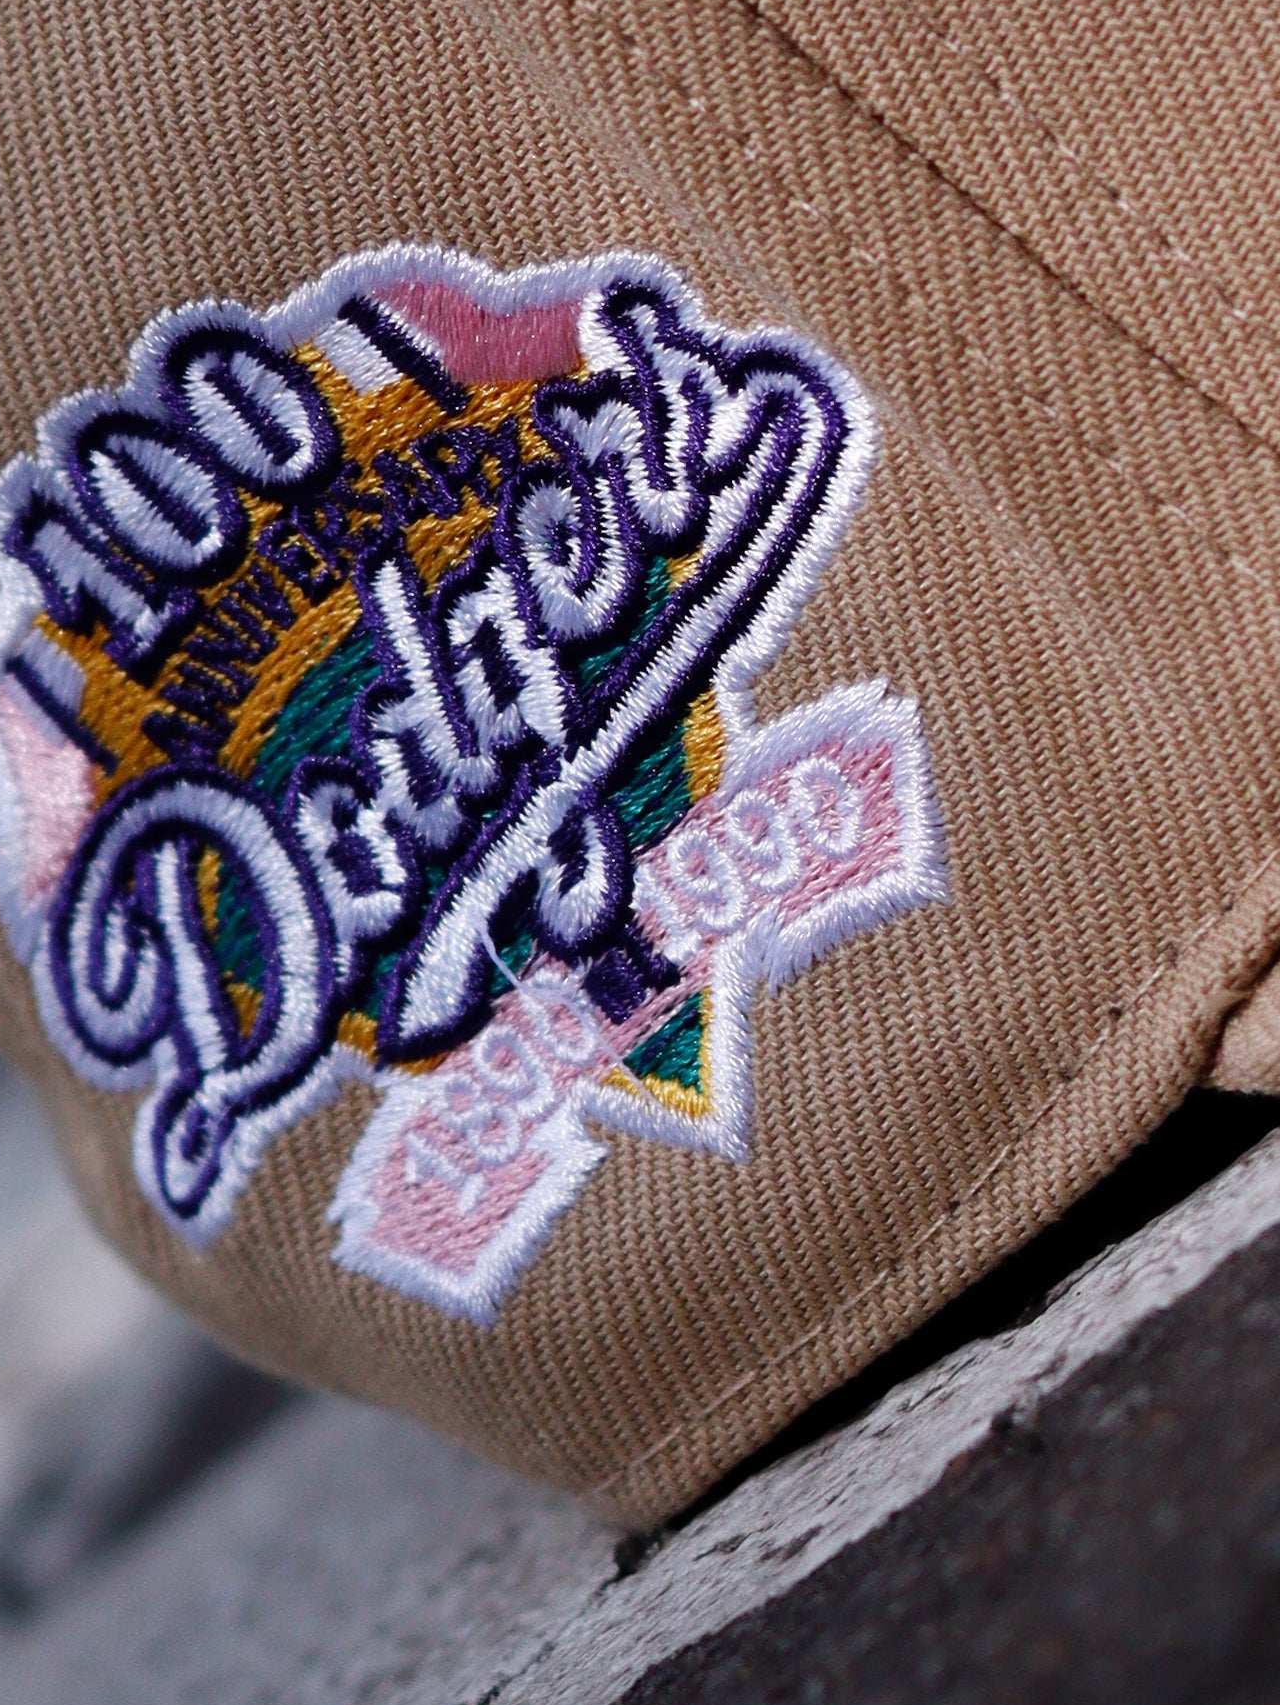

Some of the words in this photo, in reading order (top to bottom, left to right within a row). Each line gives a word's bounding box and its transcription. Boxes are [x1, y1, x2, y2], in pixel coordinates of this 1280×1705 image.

[2, 323, 345, 683] 100
[40, 279, 852, 1221] Dodgers
[630, 756, 864, 965] 1990
[404, 967, 602, 1215] 1890
